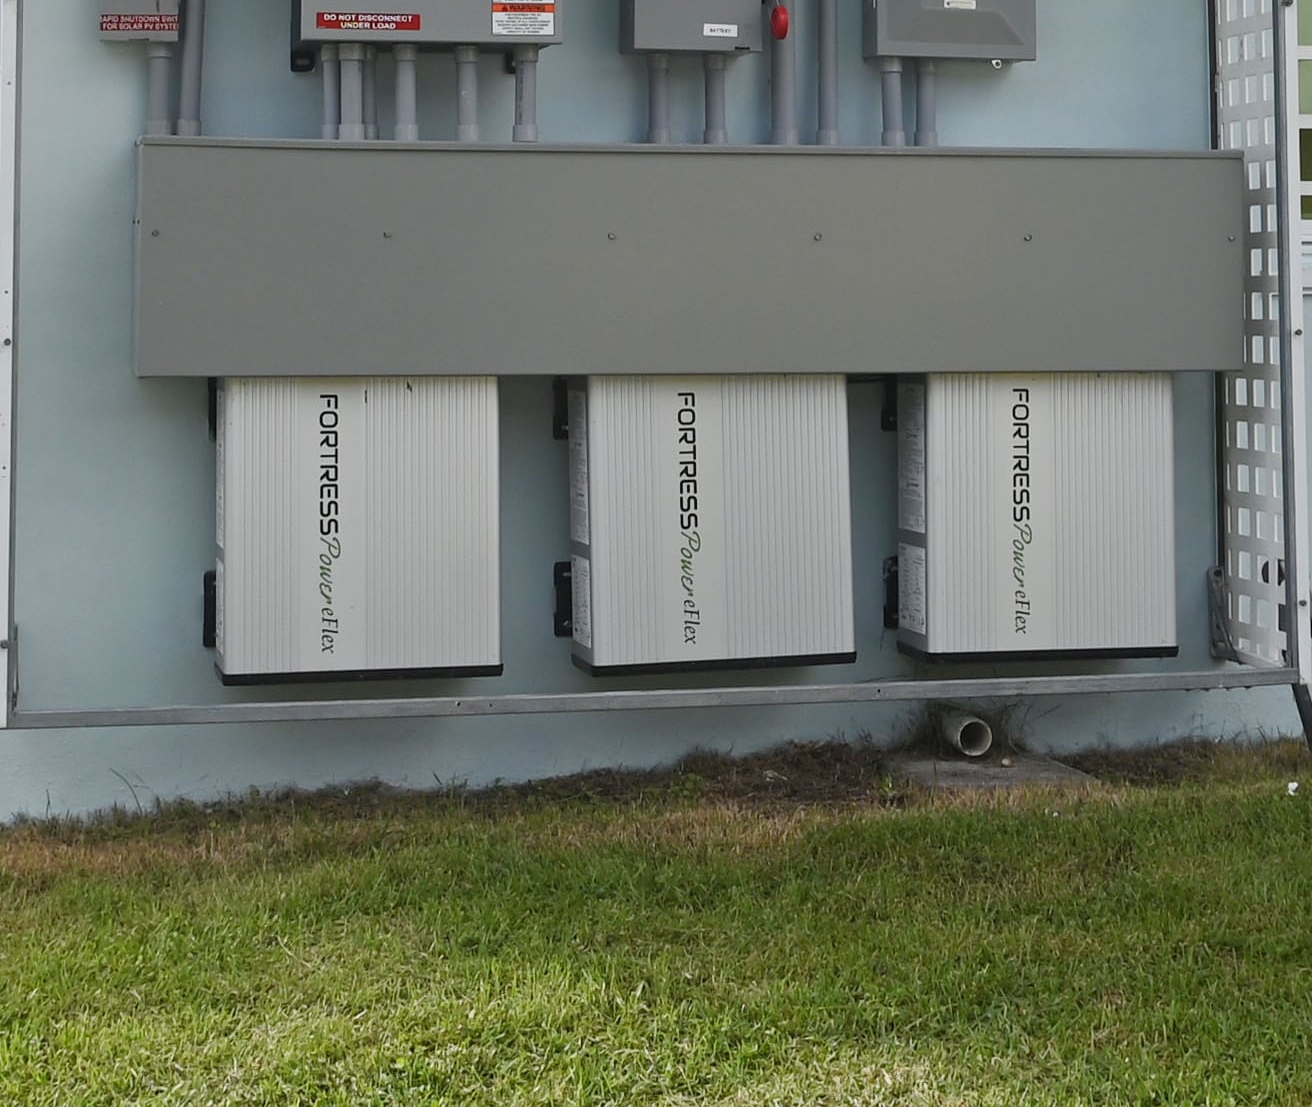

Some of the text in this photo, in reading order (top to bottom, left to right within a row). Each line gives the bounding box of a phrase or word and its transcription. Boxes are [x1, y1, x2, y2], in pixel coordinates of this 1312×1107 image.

[323, 13, 413, 22] DO NOT DISCONNECT
[340, 21, 371, 29] UNDER
[319, 394, 338, 536] FORTRESS
[677, 393, 698, 530] FORTRESS
[1012, 388, 1029, 522] FORTRESS
